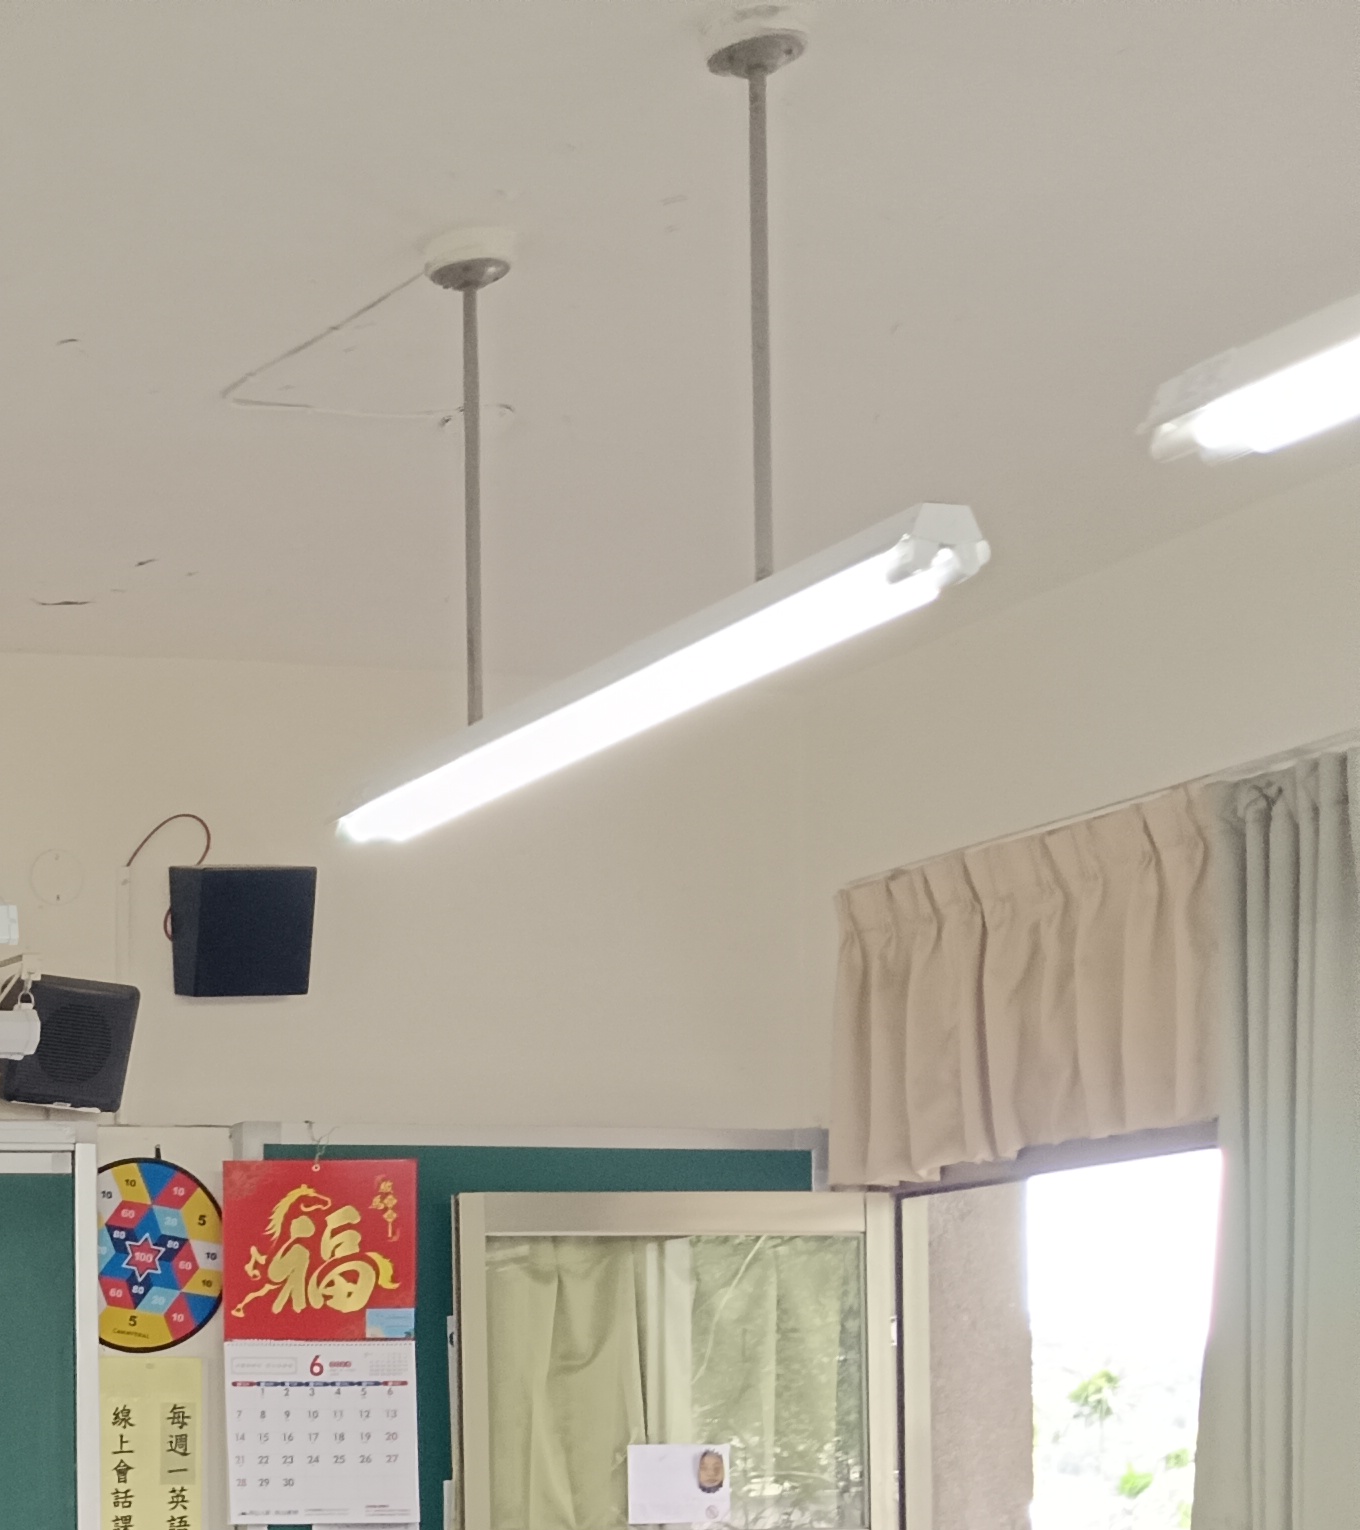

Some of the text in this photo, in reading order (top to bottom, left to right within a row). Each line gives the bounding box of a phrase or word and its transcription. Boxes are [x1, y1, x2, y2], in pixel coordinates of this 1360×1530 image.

[125, 1179, 136, 1187] 10
[101, 1191, 112, 1199] 10
[173, 1187, 185, 1195] 10
[198, 1215, 206, 1226] 5
[167, 1240, 179, 1249] 80
[134, 1252, 153, 1262] 100
[206, 1252, 217, 1260] 10
[266, 1204, 378, 1314] 福
[132, 1286, 144, 1294] 80
[129, 1315, 137, 1326] 5
[309, 1355, 324, 1376] 6
[361, 1388, 367, 1396] 5
[260, 1411, 266, 1419] 8
[284, 1411, 290, 1419] 9
[308, 1410, 319, 1418] 10
[359, 1410, 370, 1418] 12
[259, 1433, 269, 1441] 15
[283, 1433, 293, 1441] 16
[308, 1433, 319, 1441] 17
[333, 1433, 345, 1441] 18
[360, 1433, 371, 1441] 19
[386, 1432, 398, 1440] 20
[258, 1456, 269, 1464] 22
[282, 1456, 293, 1464] 23
[307, 1456, 319, 1464] 24
[333, 1455, 345, 1463] 25
[359, 1455, 372, 1463] 26
[386, 1455, 398, 1463] 27
[237, 1479, 294, 1487] 28 29 30
